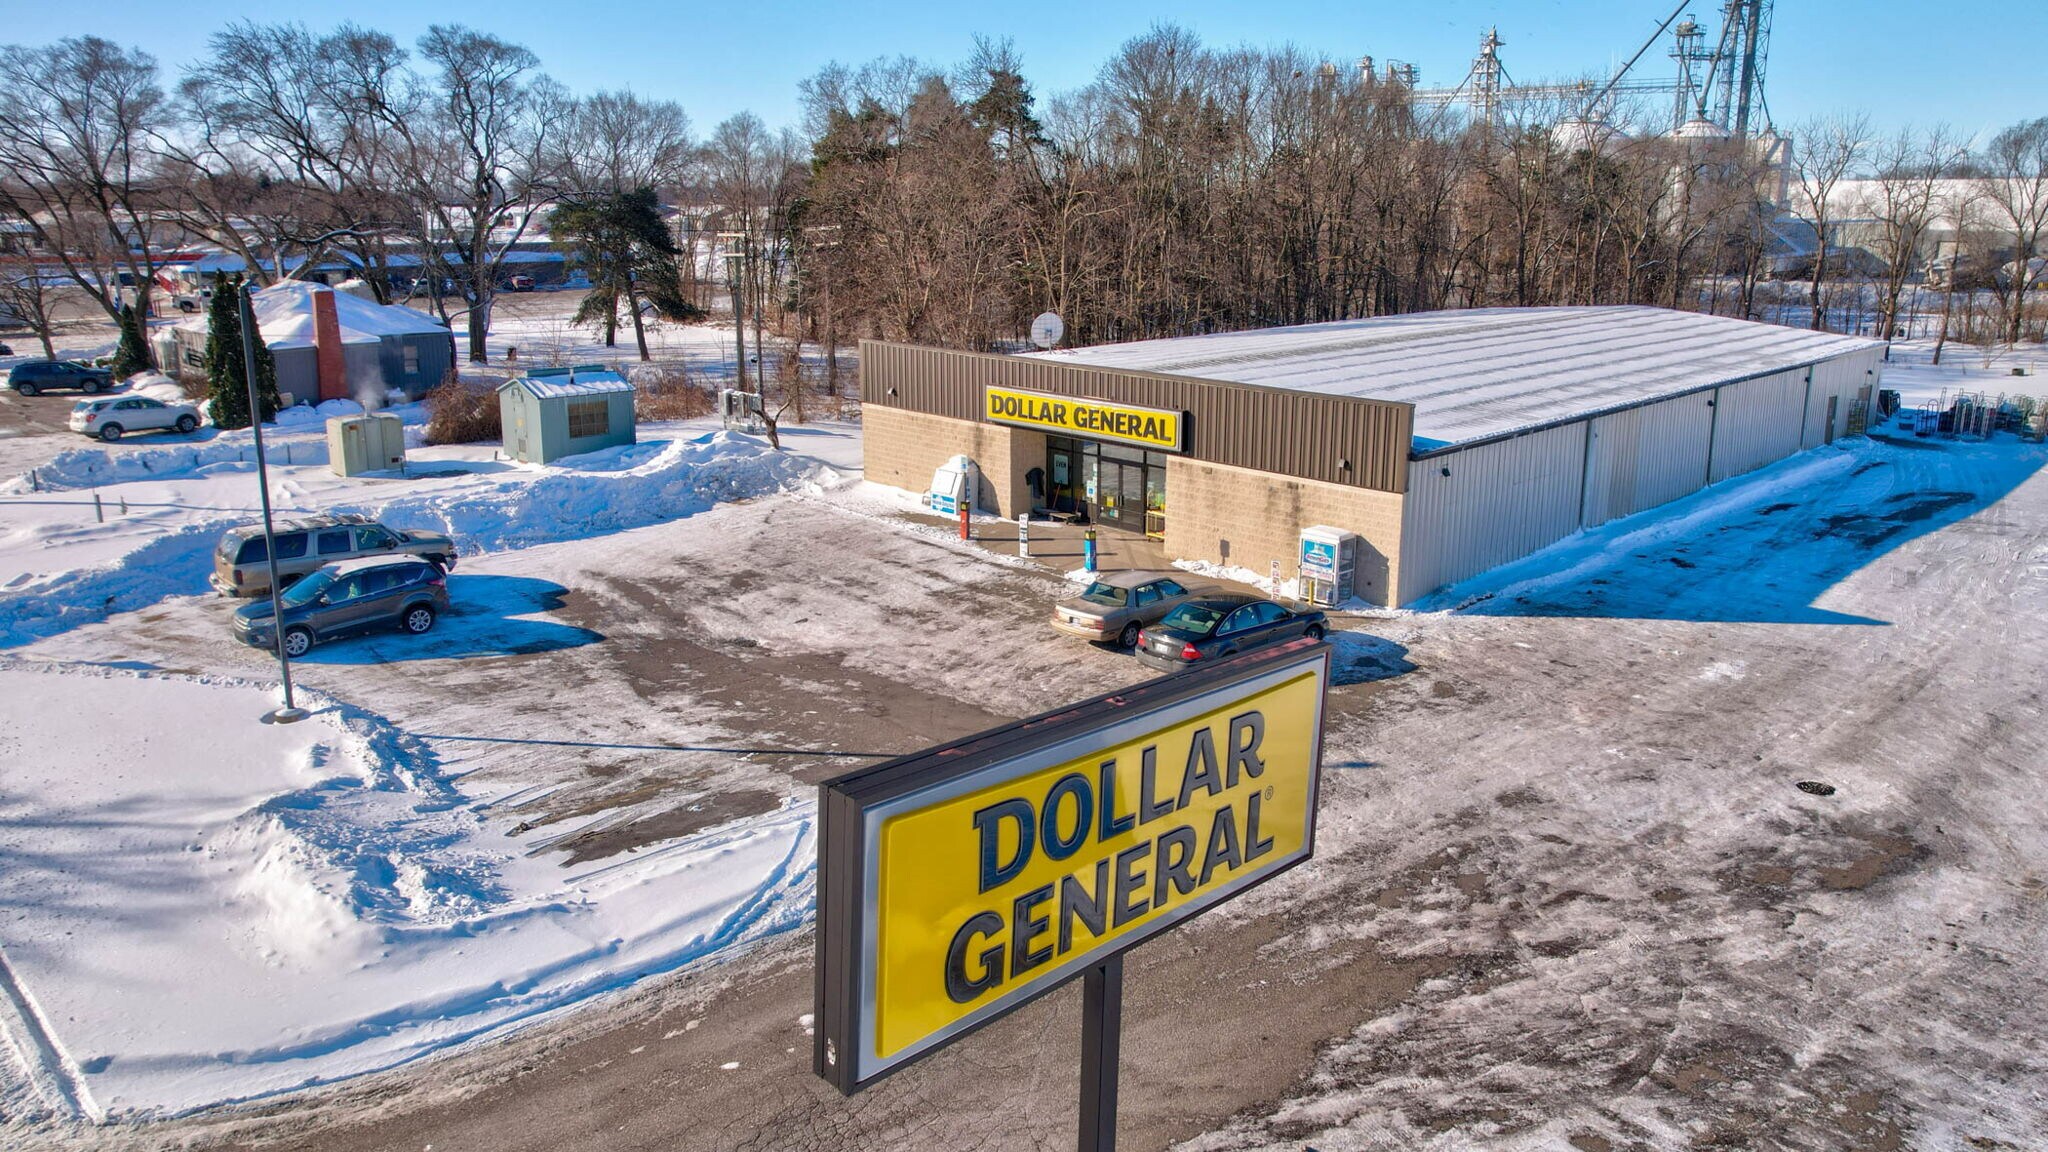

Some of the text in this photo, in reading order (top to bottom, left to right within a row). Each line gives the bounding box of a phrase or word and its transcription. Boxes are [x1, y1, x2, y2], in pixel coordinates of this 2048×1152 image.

[991, 395, 1172, 442] DOLLAR GENERAL
[973, 711, 1265, 894] DOLLAR
[945, 790, 1274, 1003] GENERAL
